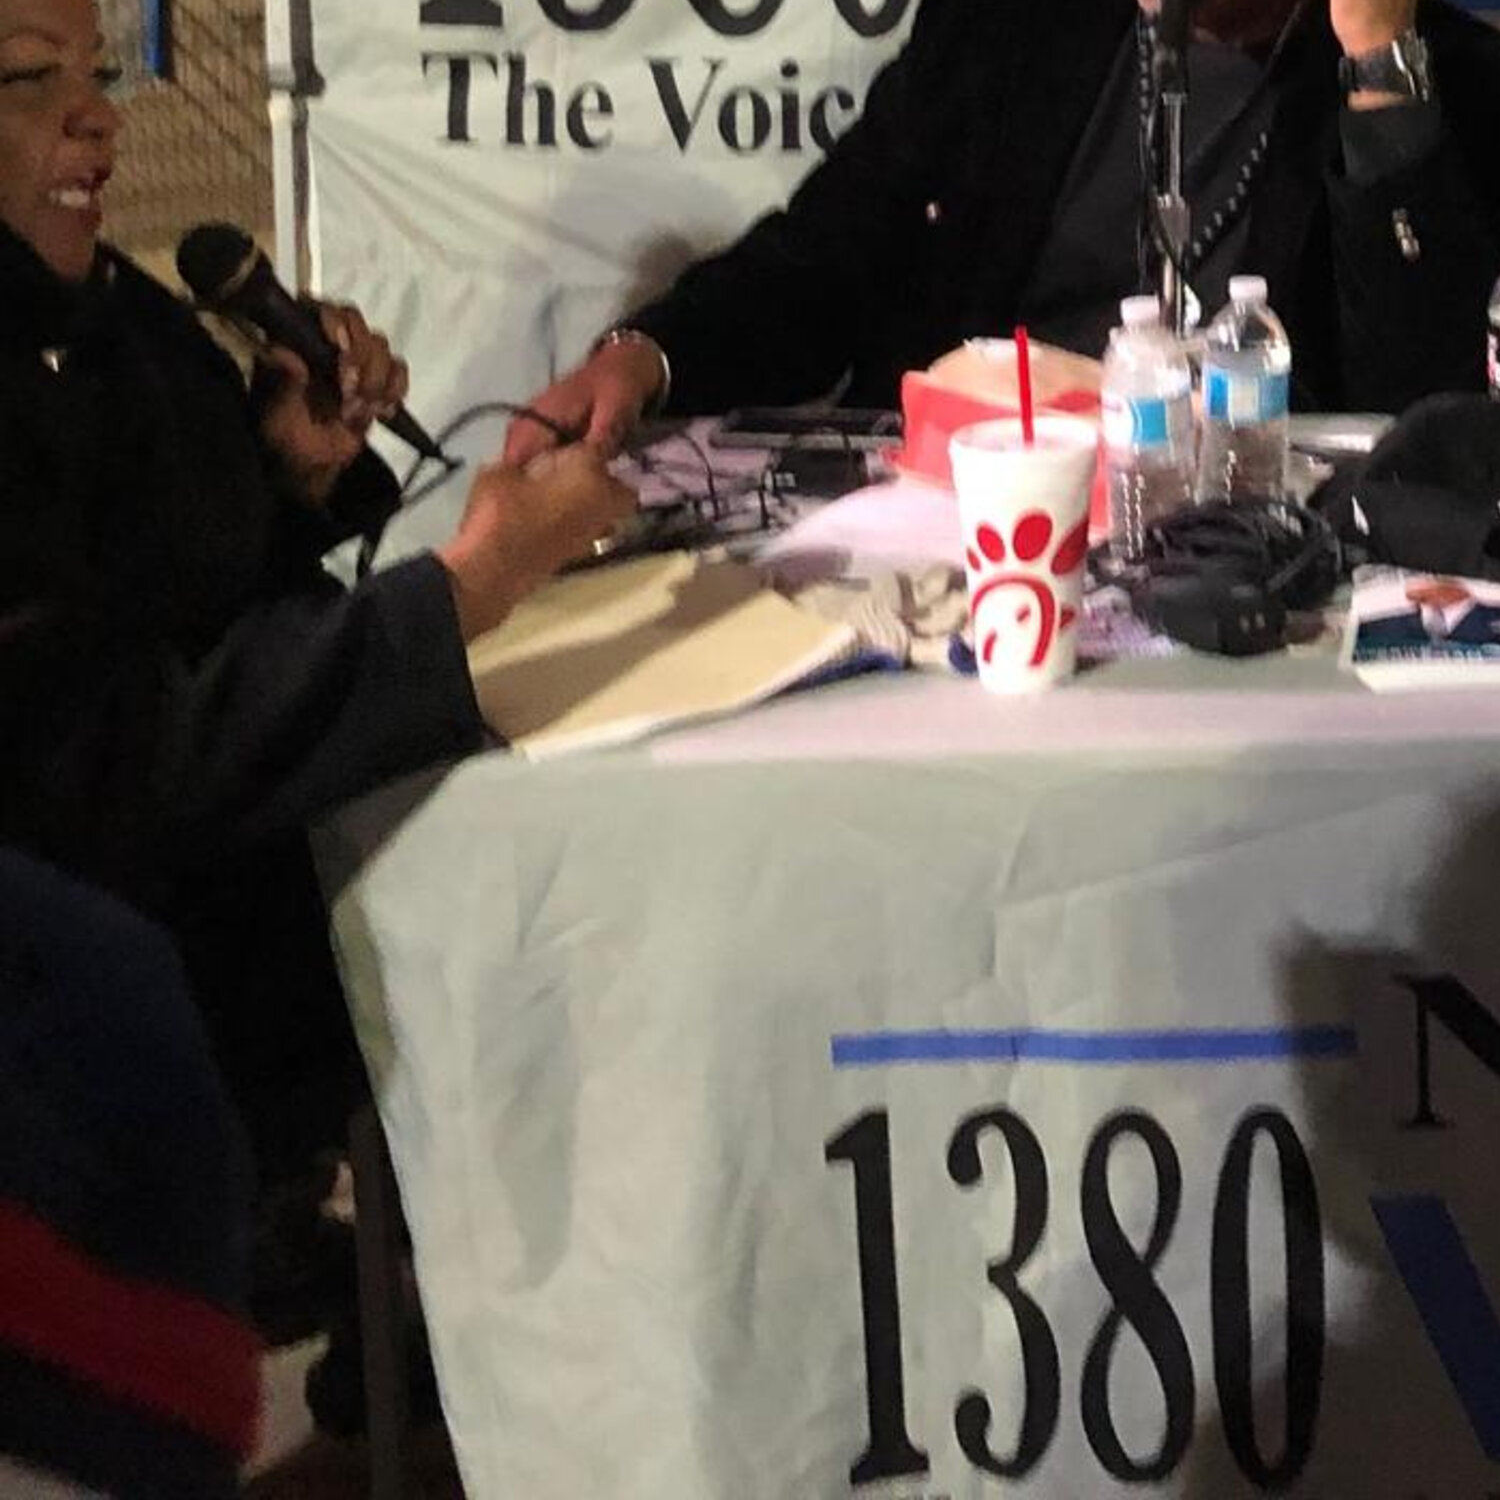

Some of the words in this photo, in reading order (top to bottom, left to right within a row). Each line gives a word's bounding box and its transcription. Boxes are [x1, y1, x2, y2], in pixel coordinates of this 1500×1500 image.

[421, 49, 614, 150] The
[645, 56, 858, 156] Voic
[824, 1104, 1326, 1491] 1380
